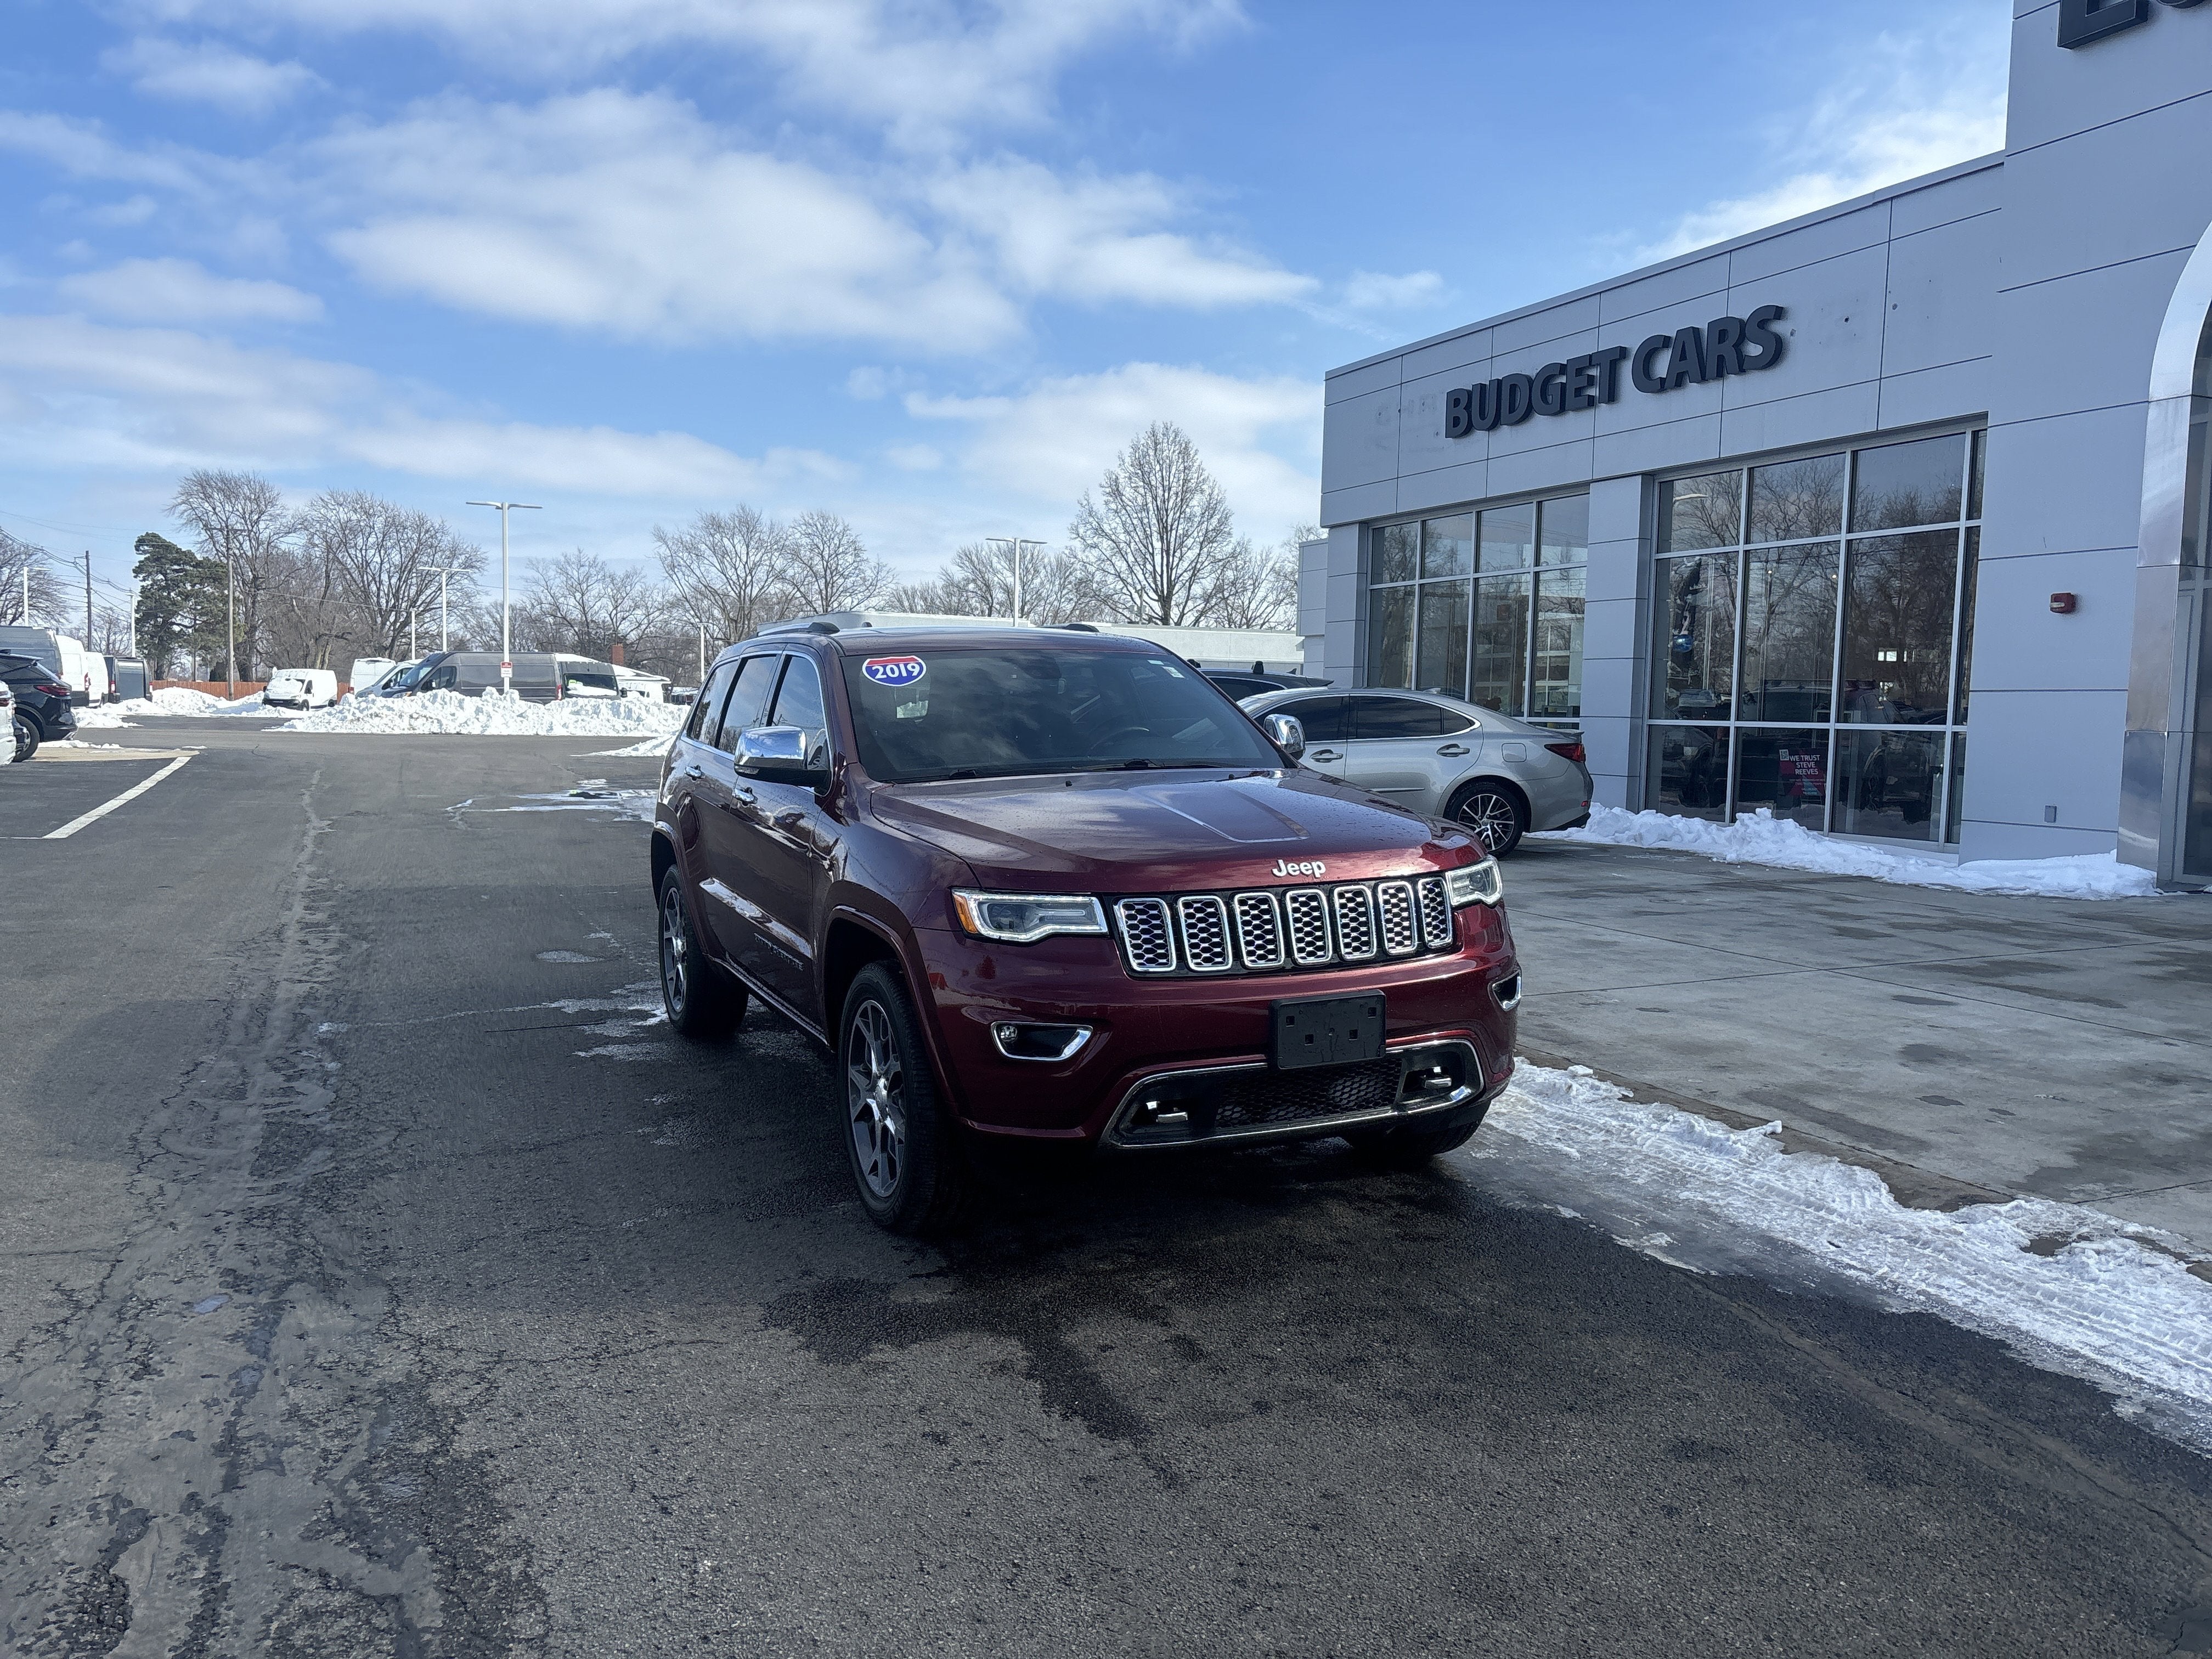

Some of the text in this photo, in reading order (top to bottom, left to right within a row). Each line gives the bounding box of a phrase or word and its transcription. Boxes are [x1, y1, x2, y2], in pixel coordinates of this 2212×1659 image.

[1445, 304, 1784, 438] BUDGET CARS
[872, 663, 920, 679] 2019
[1272, 859, 1326, 878] Jeep
